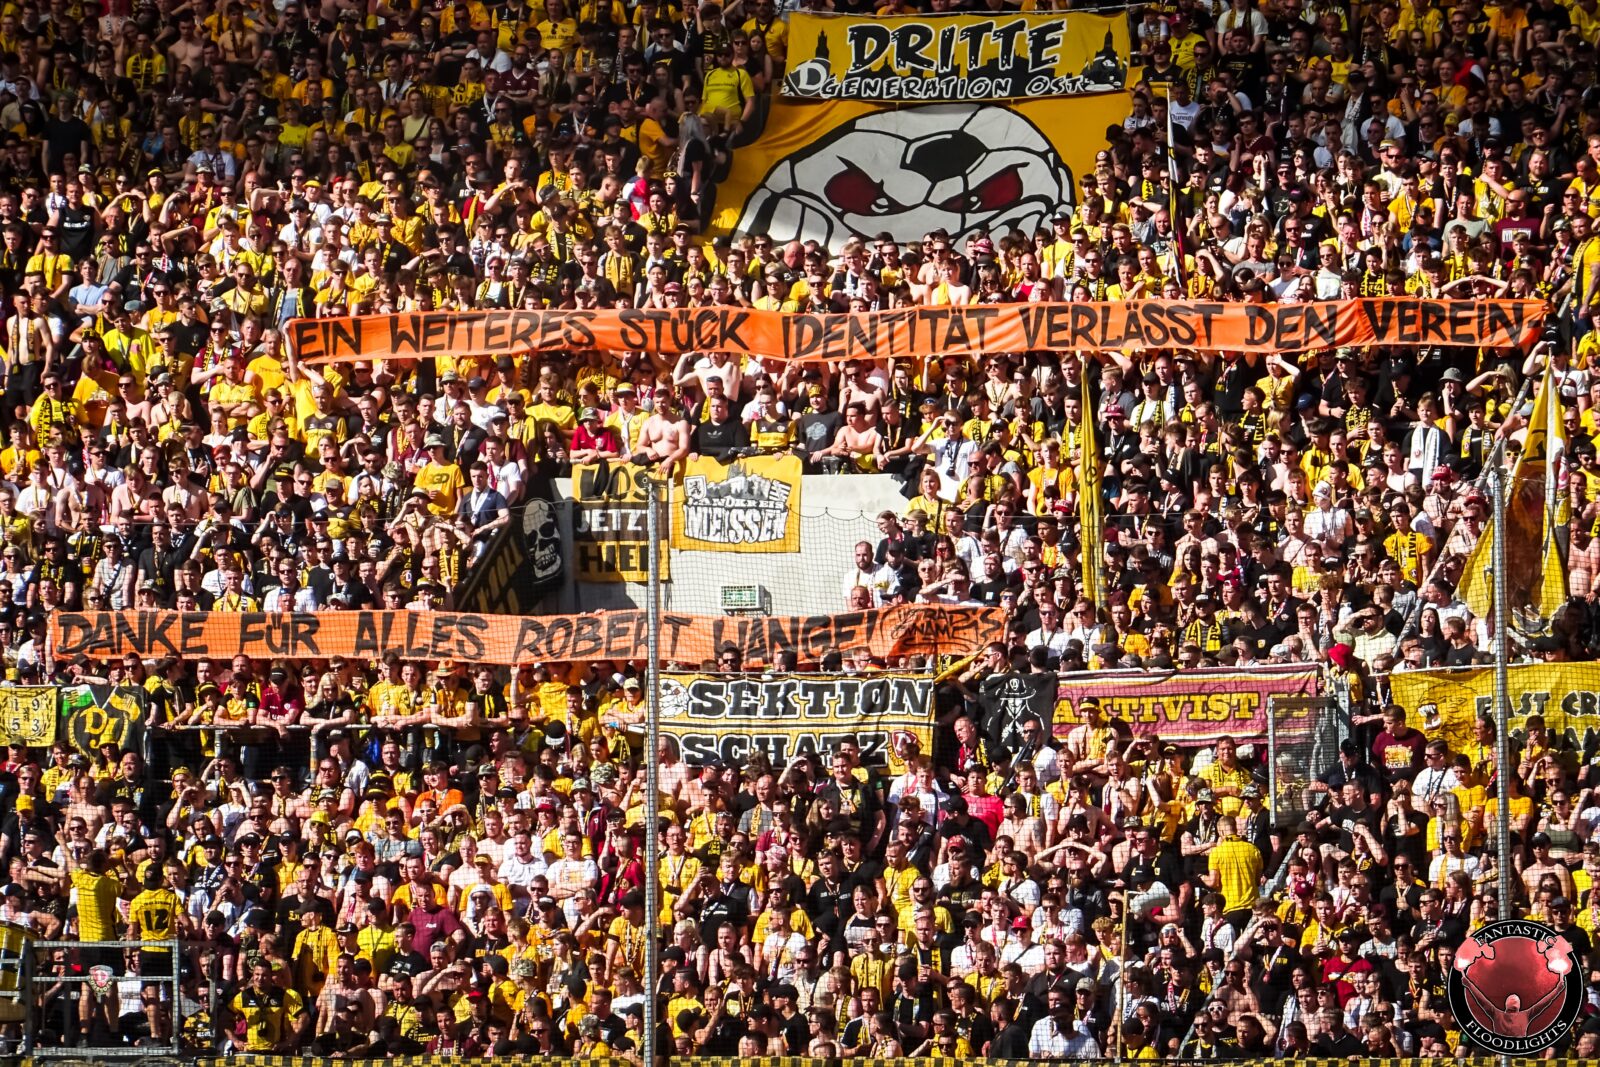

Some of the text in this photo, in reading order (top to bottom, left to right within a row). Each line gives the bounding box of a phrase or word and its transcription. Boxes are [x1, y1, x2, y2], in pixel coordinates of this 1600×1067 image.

[847, 18, 1067, 76] DRITTE
[819, 75, 1081, 98] GENERATION OST
[295, 319, 361, 358] EIN
[390, 309, 597, 352] WEITERES
[618, 308, 749, 351] STÜCK
[781, 306, 999, 359] IDENTITÄT
[1018, 301, 1222, 349] VERLÄSST
[1245, 303, 1339, 349] DEN
[684, 505, 788, 544] MEISSEN
[57, 611, 208, 654] DANKE
[240, 612, 320, 655] FÜR
[353, 611, 489, 660] ALLES
[687, 678, 934, 719] SEKTION
[143, 908, 170, 932] 12
